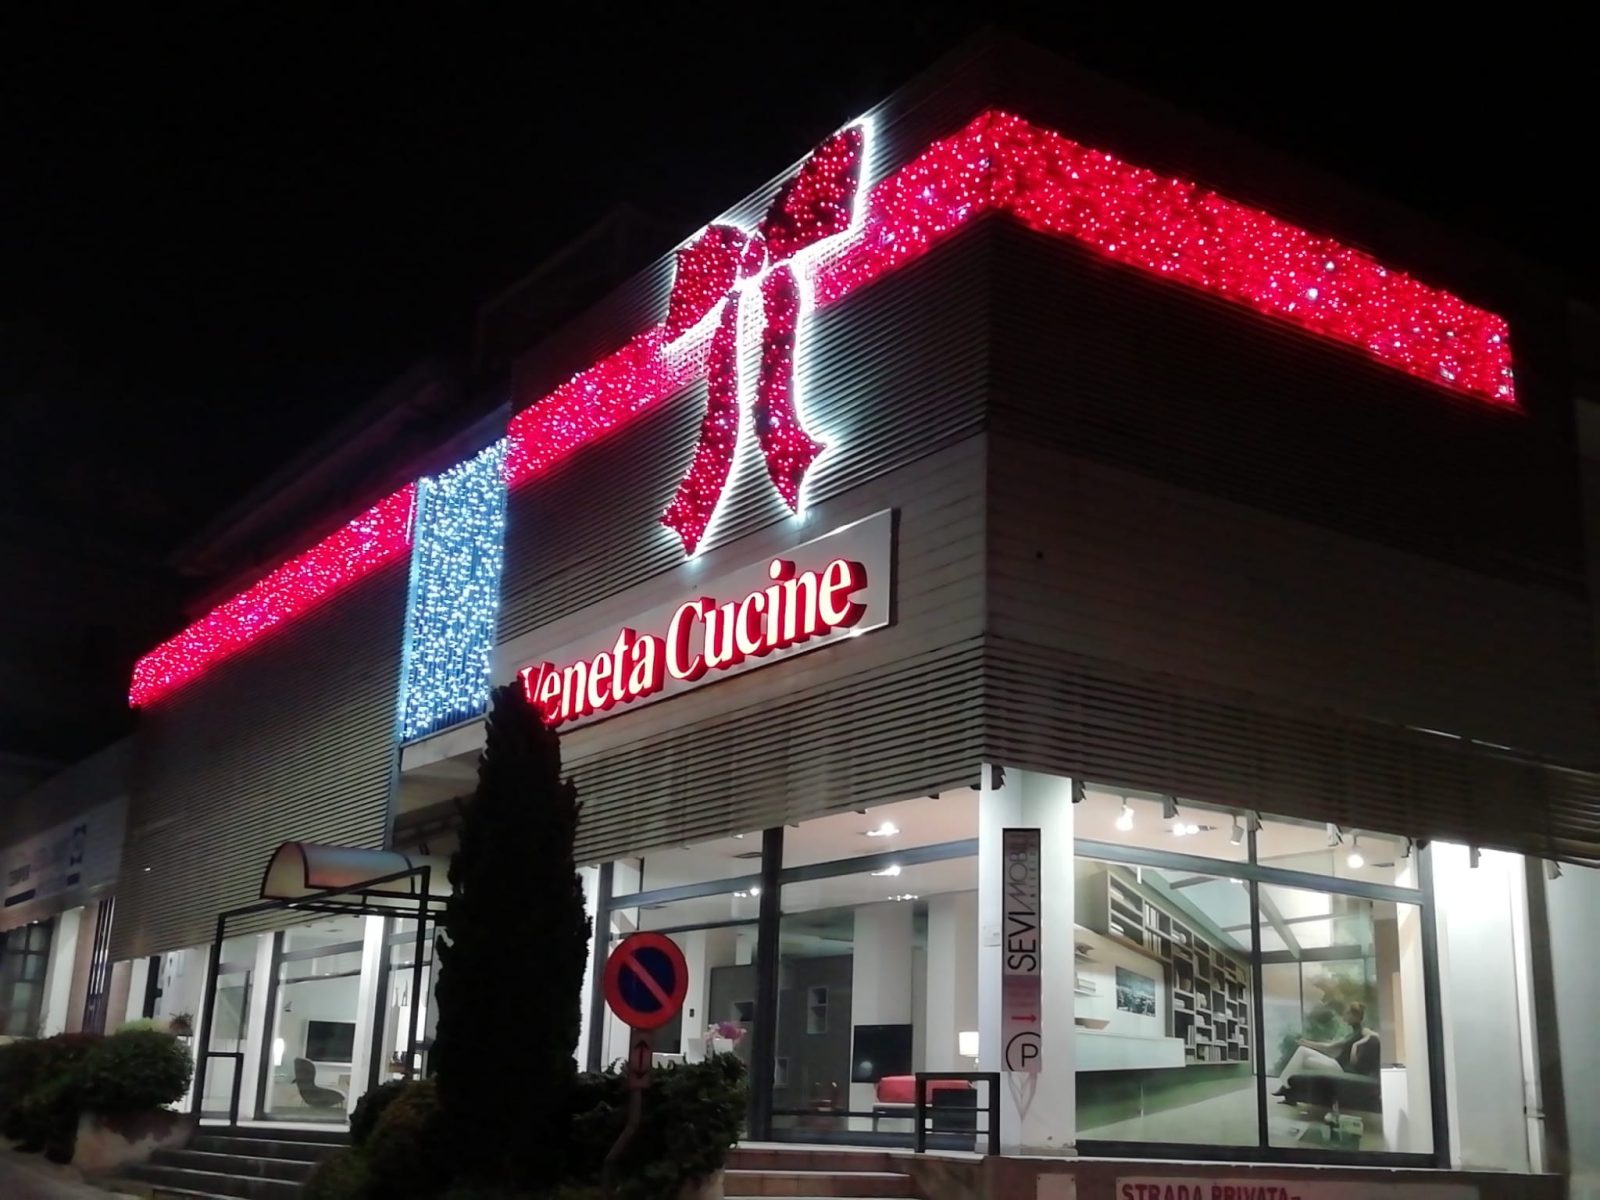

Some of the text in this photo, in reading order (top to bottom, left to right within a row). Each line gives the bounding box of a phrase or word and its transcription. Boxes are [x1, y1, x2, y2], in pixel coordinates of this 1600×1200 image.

[518, 558, 867, 725] Veneta Cucine
[1021, 1043, 1039, 1068] P
[1122, 1183, 1203, 1200] STRADA
